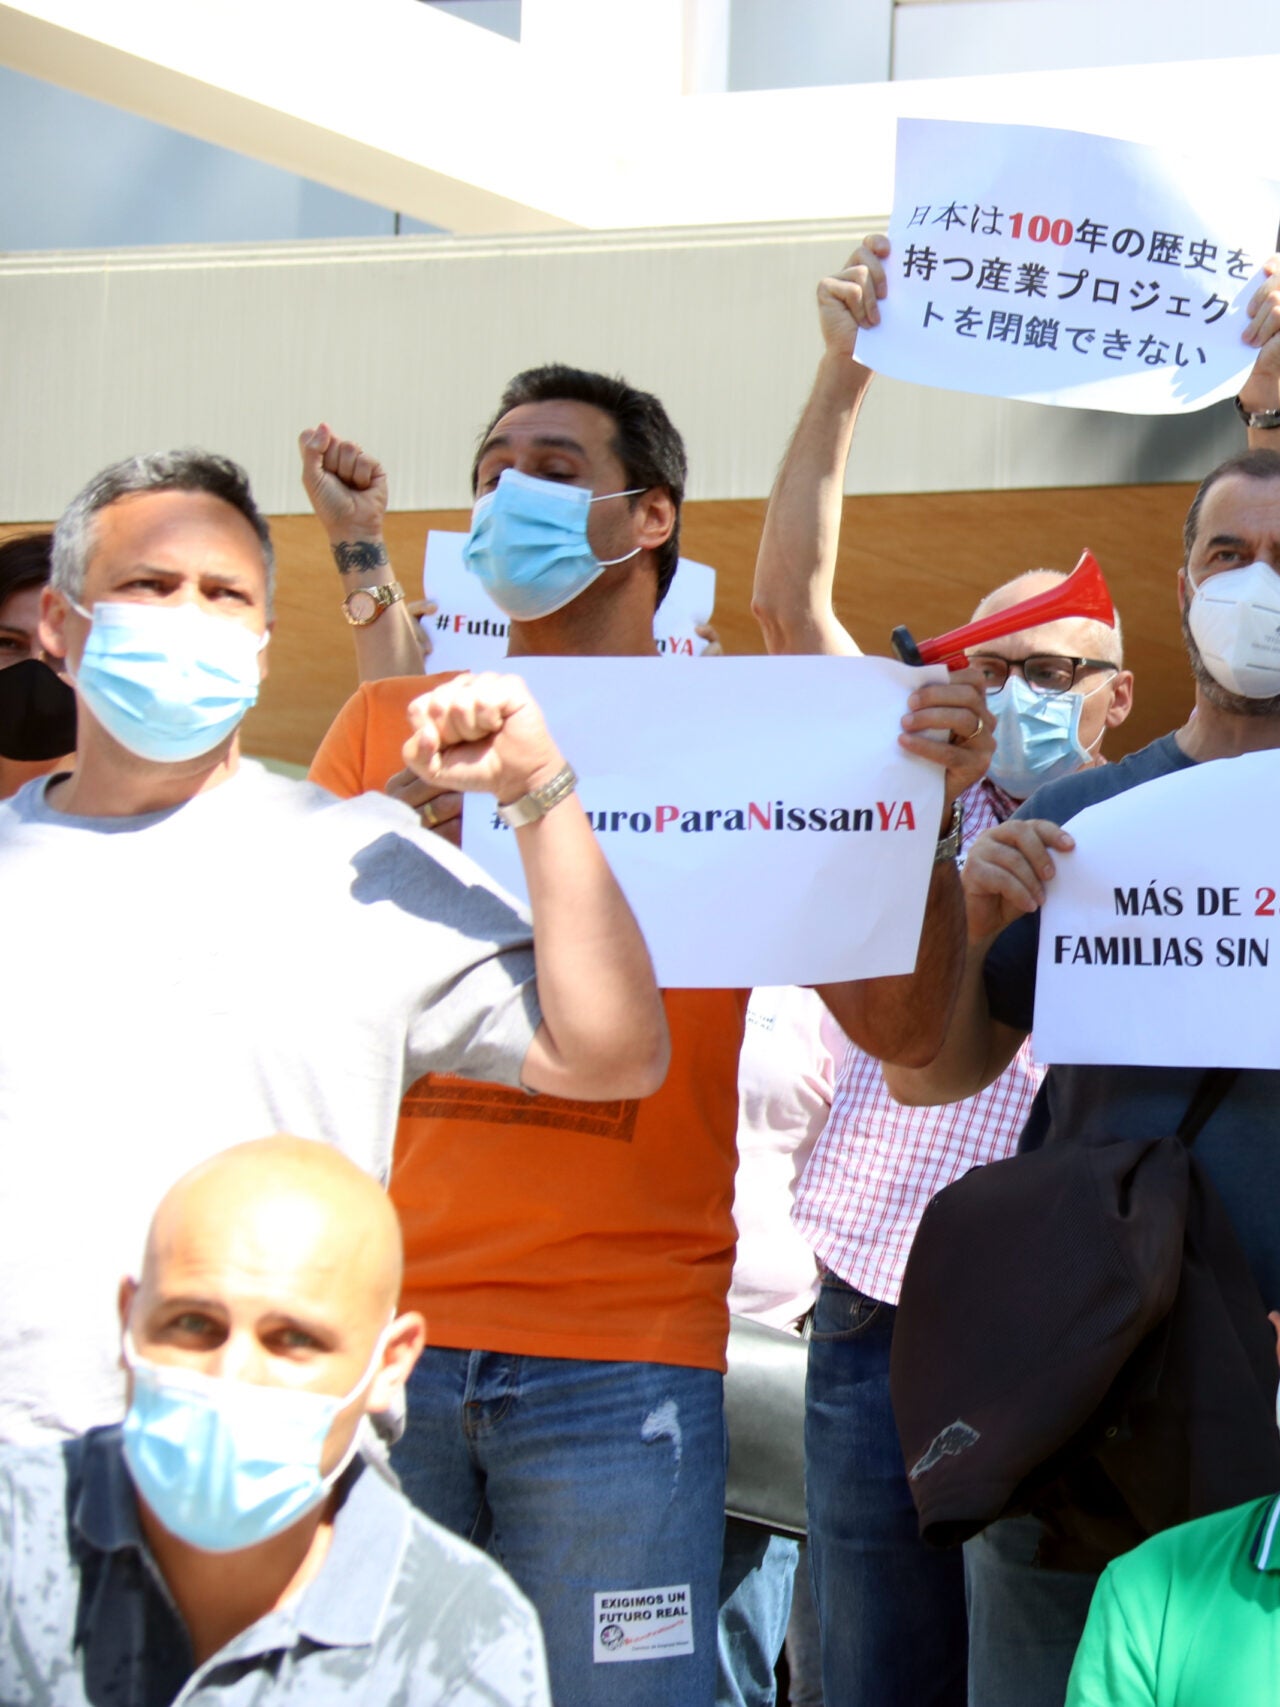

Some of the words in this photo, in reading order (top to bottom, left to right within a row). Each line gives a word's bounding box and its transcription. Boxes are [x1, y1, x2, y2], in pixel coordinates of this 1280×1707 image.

[905, 200, 1254, 281] 日本は100年の歴史を
[902, 243, 1230, 325] 持つ産業プロジェク
[920, 300, 1206, 368] トを閉鎖できない
[489, 801, 916, 834] #uroParaNissanYA
[1113, 880, 1184, 916] MÁS
[1197, 887, 1241, 916] DE
[1053, 935, 1204, 967] FAMILIAS
[1215, 937, 1270, 968] SIN
[599, 1610, 652, 1624] FUTURO
[656, 1606, 688, 1619] REAL
[601, 1594, 664, 1609] EXIGIMOS
[667, 1591, 686, 1603] UN
